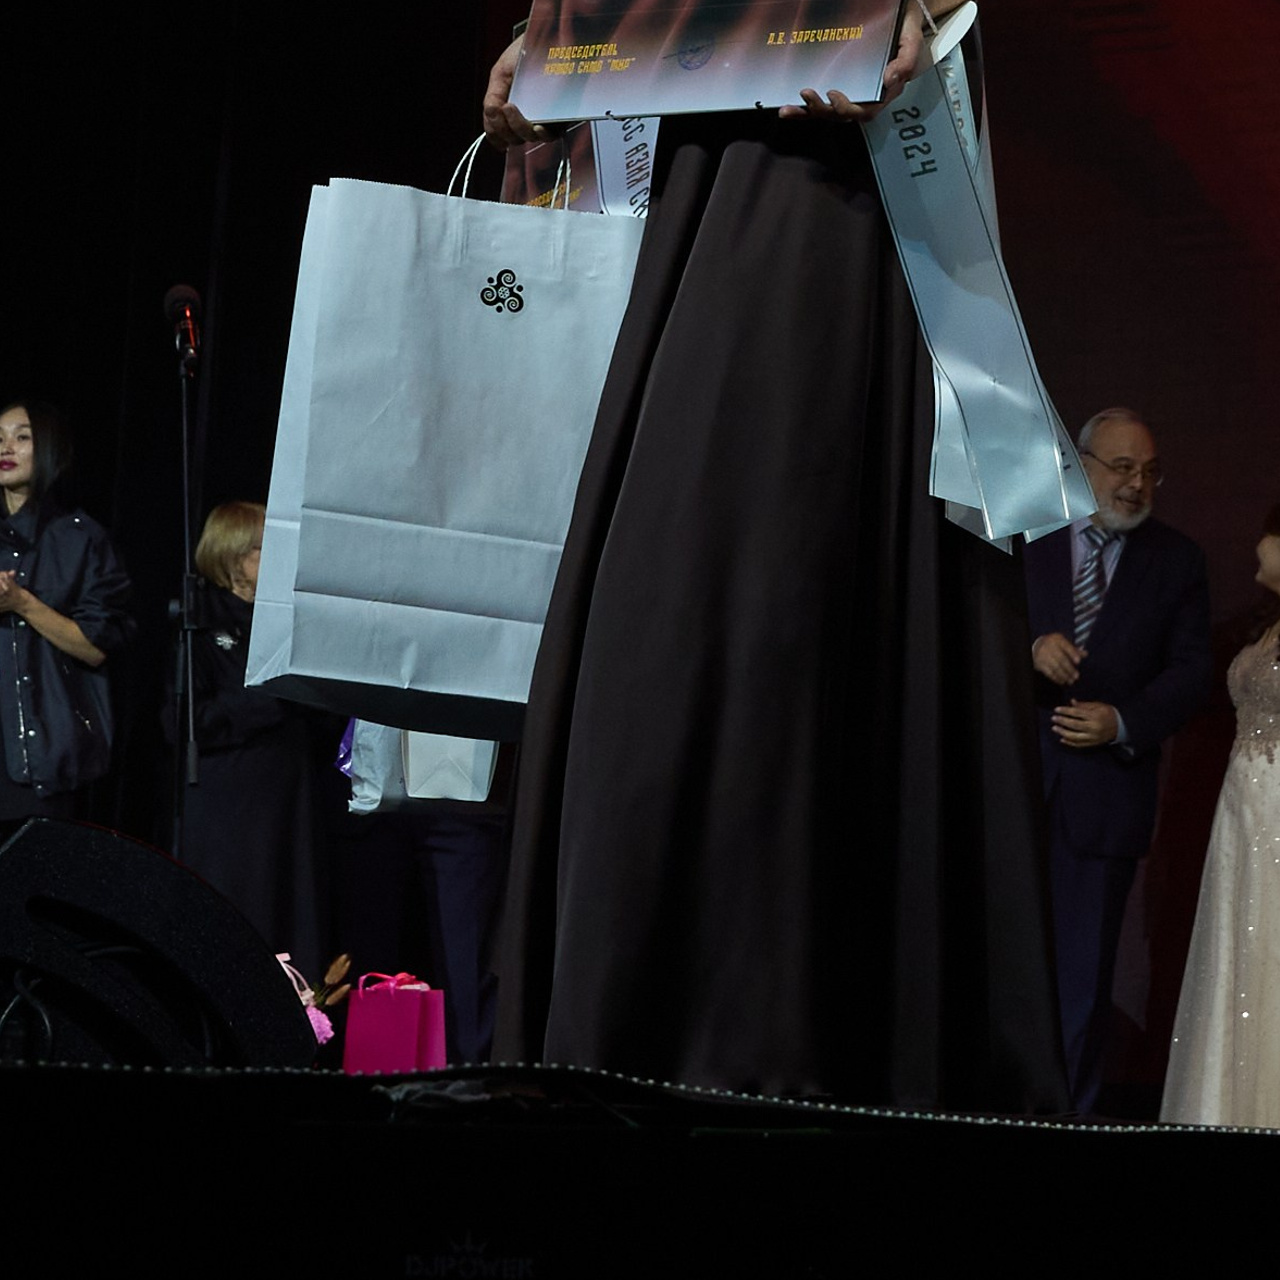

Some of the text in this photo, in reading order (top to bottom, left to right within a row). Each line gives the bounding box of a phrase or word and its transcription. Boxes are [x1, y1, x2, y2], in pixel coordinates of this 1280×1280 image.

[790, 24, 864, 44] ЗАРЕЧАНСКИЙ
[547, 43, 618, 60] ПРЕДСЕДАТЕЛЬ
[891, 104, 938, 178] 2024
[624, 142, 650, 190] АЗИЯ
